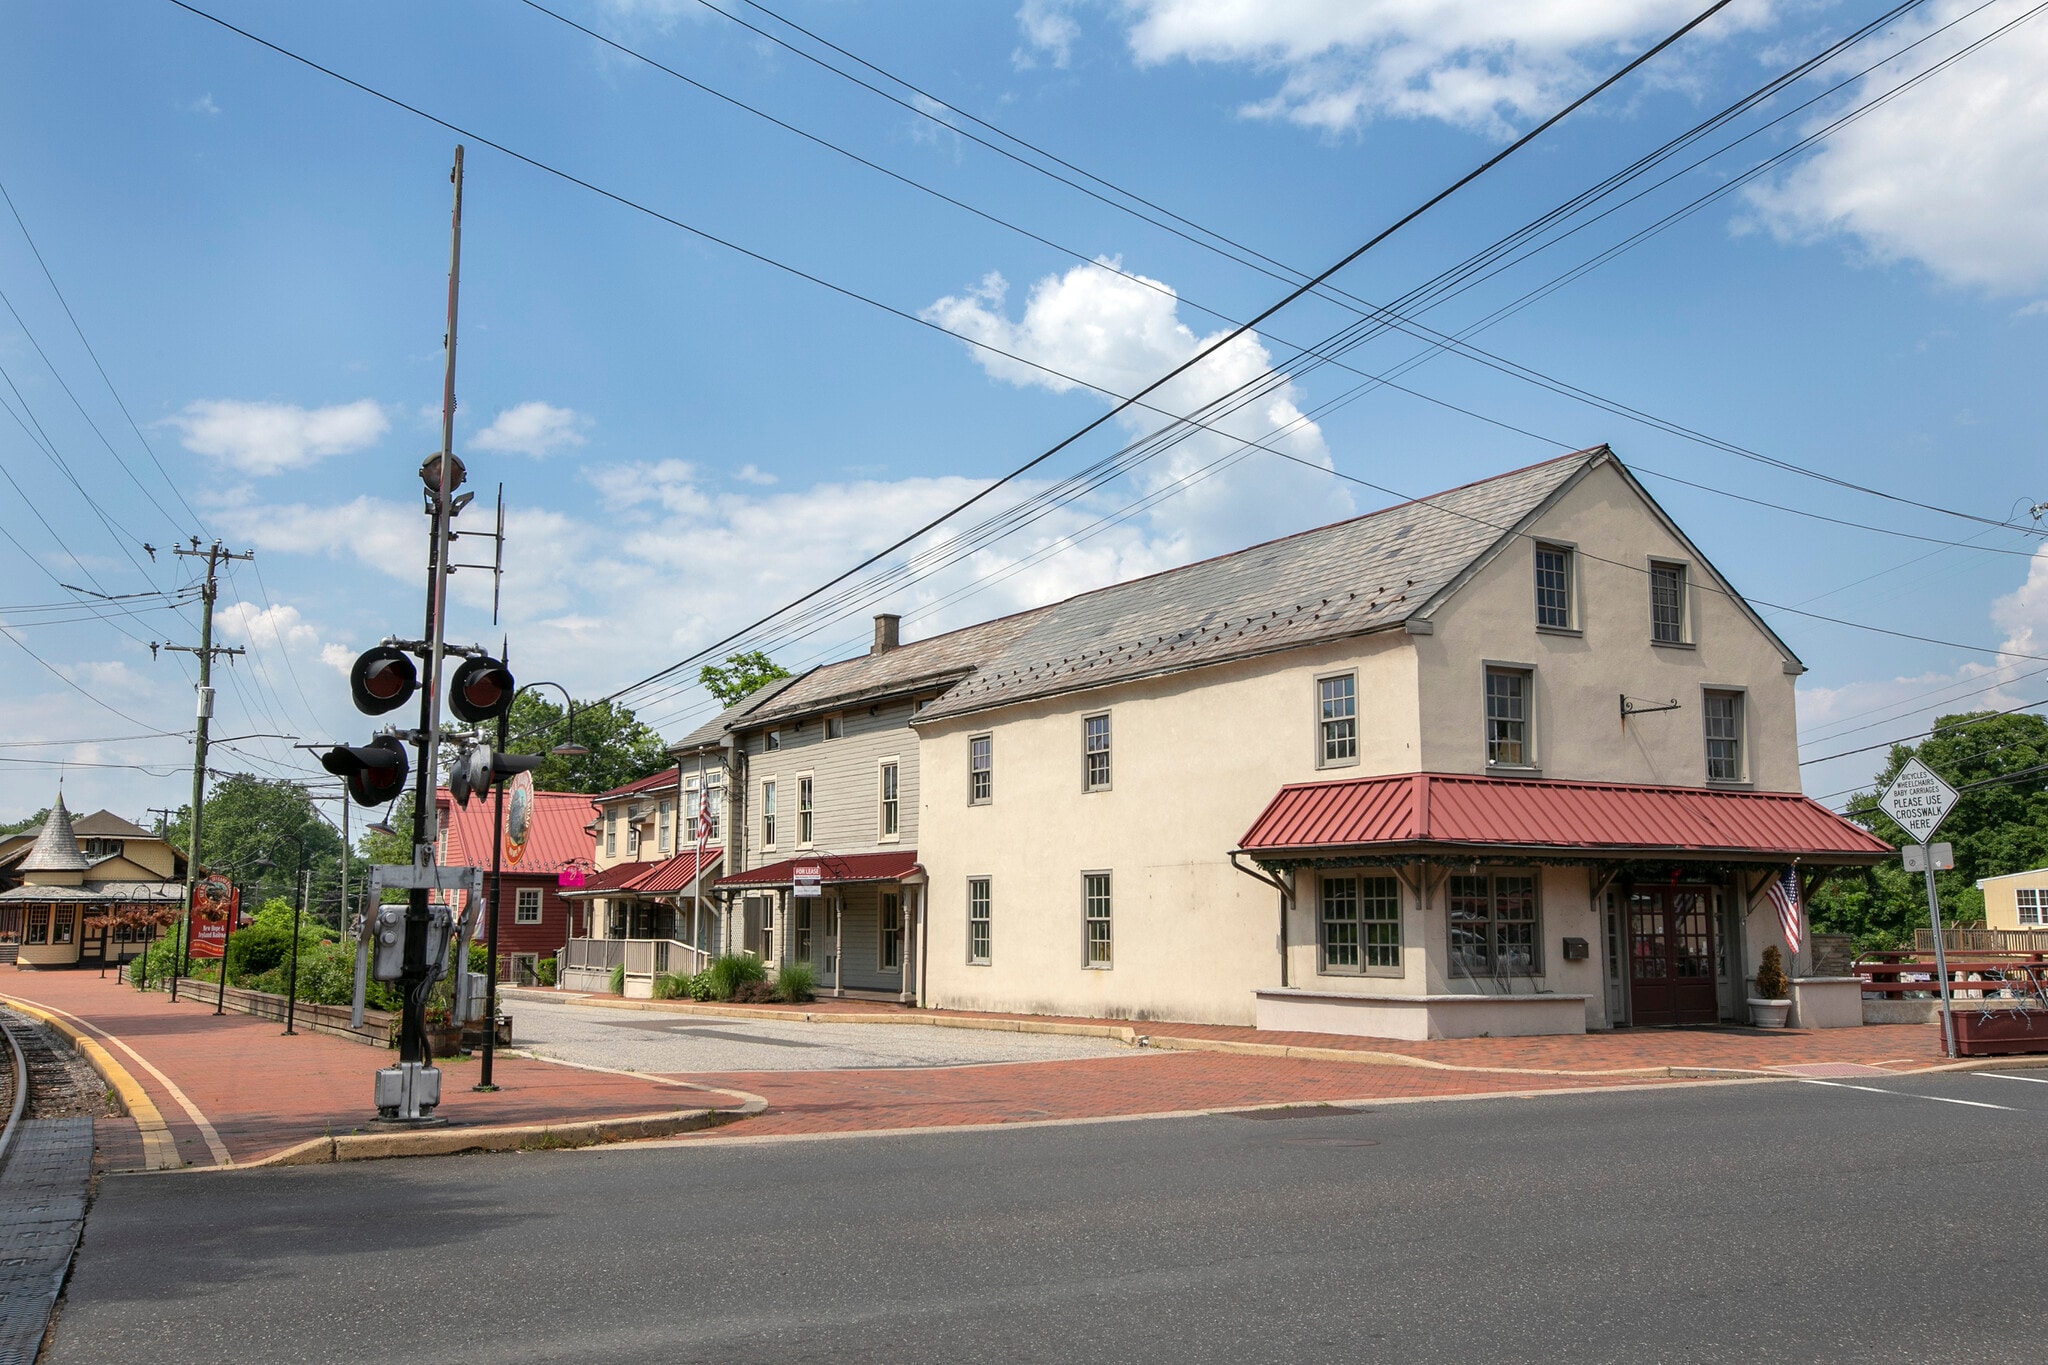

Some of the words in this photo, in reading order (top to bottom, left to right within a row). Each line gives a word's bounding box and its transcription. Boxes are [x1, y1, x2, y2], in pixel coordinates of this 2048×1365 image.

[1902, 772, 1927, 780] BICYCLES
[1897, 779, 1934, 788] WHEELCHAIRS
[1910, 786, 1939, 795] CARRIAGES
[1894, 797, 1923, 808] PLEASE
[1926, 794, 1942, 805] USE
[1896, 806, 1942, 819] CROSSWALK
[1910, 819, 1931, 829] HERE
